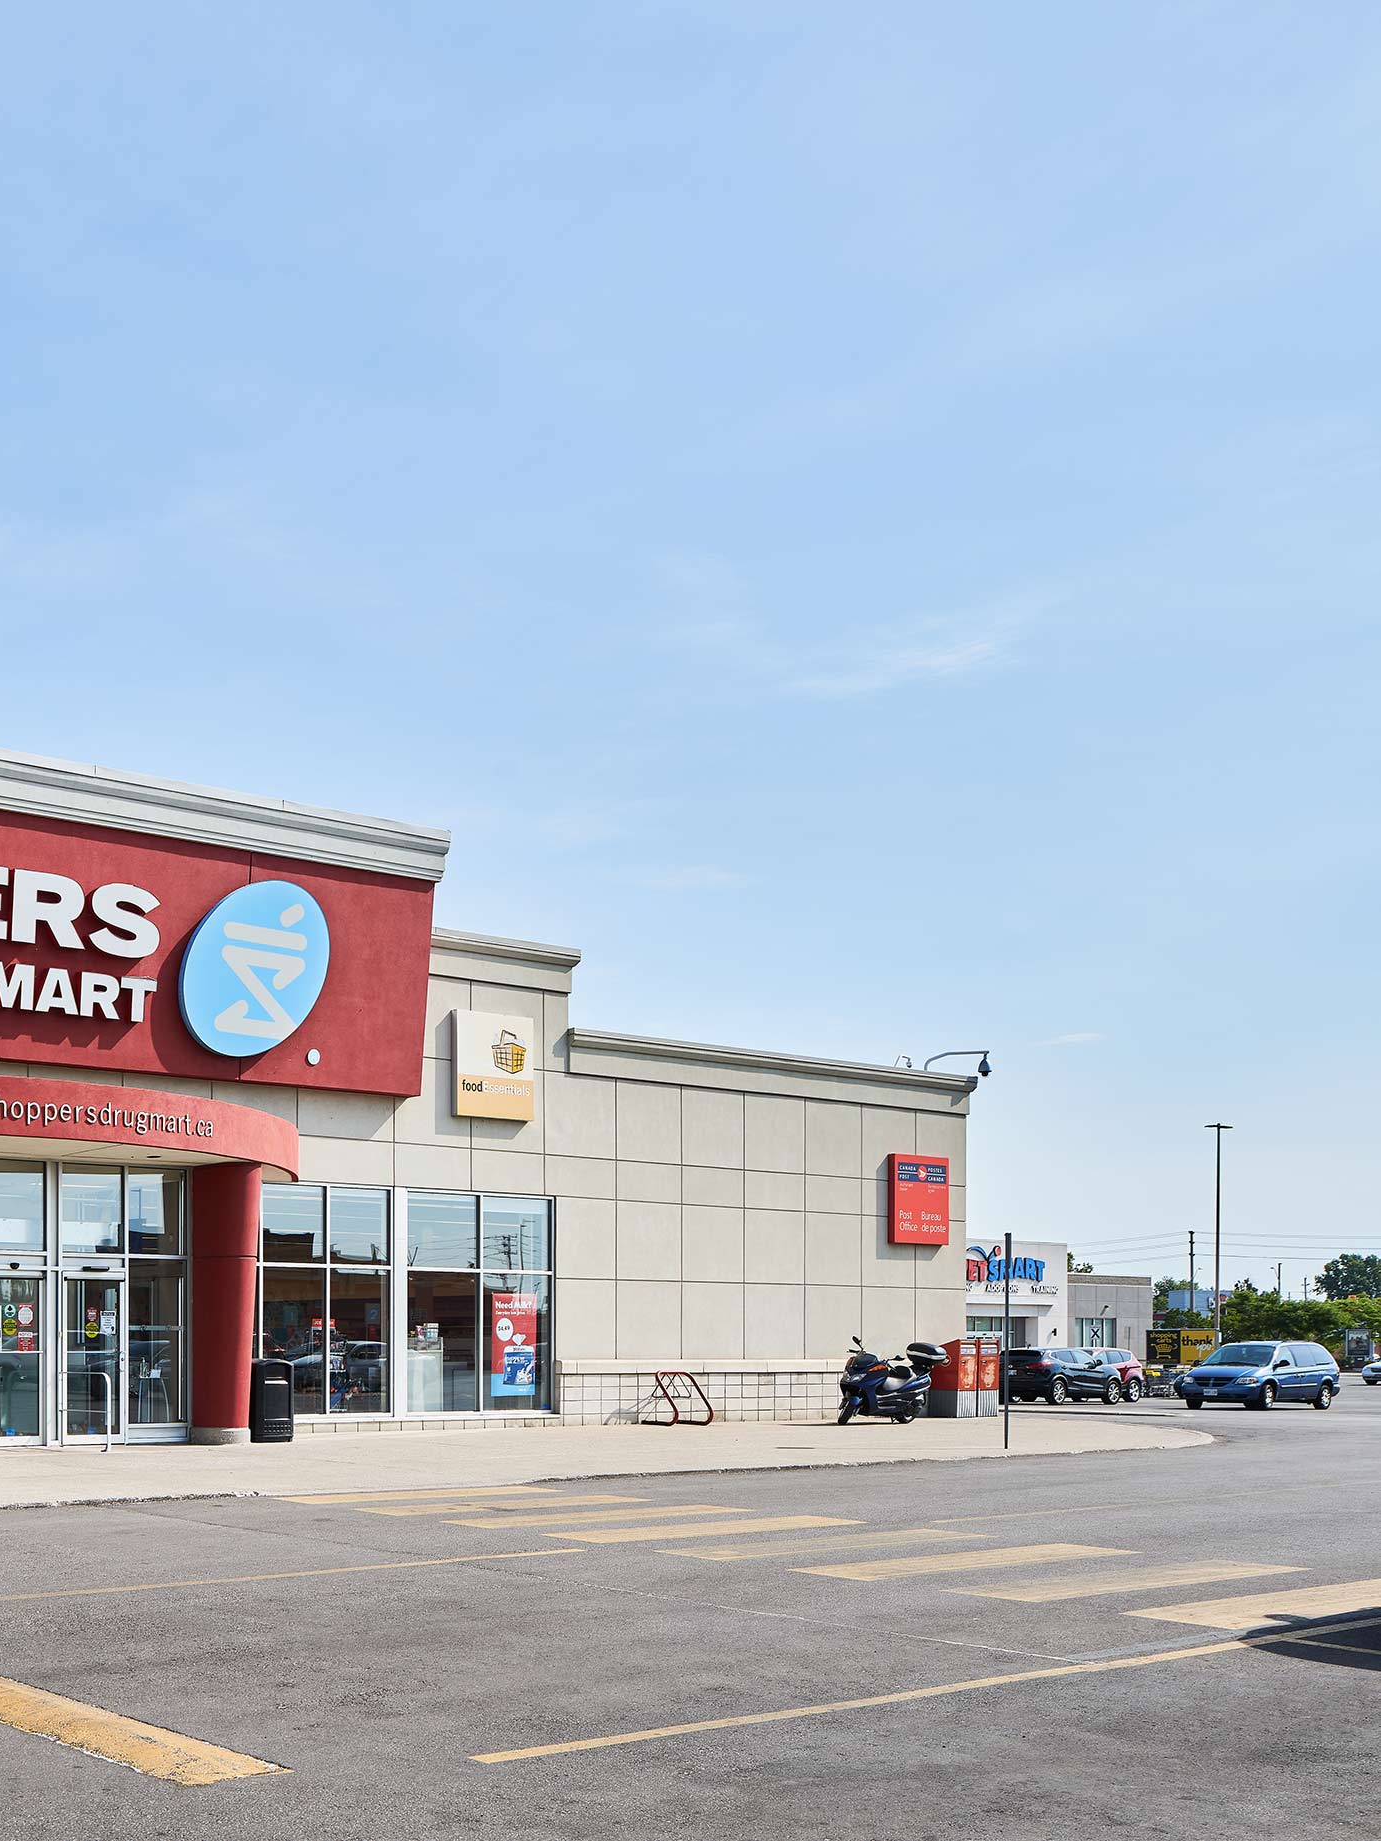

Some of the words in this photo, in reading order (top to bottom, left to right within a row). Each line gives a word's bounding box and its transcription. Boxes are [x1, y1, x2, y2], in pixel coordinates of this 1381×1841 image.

[462, 1079, 531, 1097] foodEssentials
[899, 1210, 912, 1220] Post
[921, 1211, 941, 1221] Bureau
[899, 1221, 918, 1232] Office
[921, 1223, 930, 1233] de
[930, 1224, 947, 1234] poste
[966, 1257, 1046, 1282] ETSMART
[1150, 1331, 1178, 1340] shopping
[1181, 1335, 1214, 1346] thank
